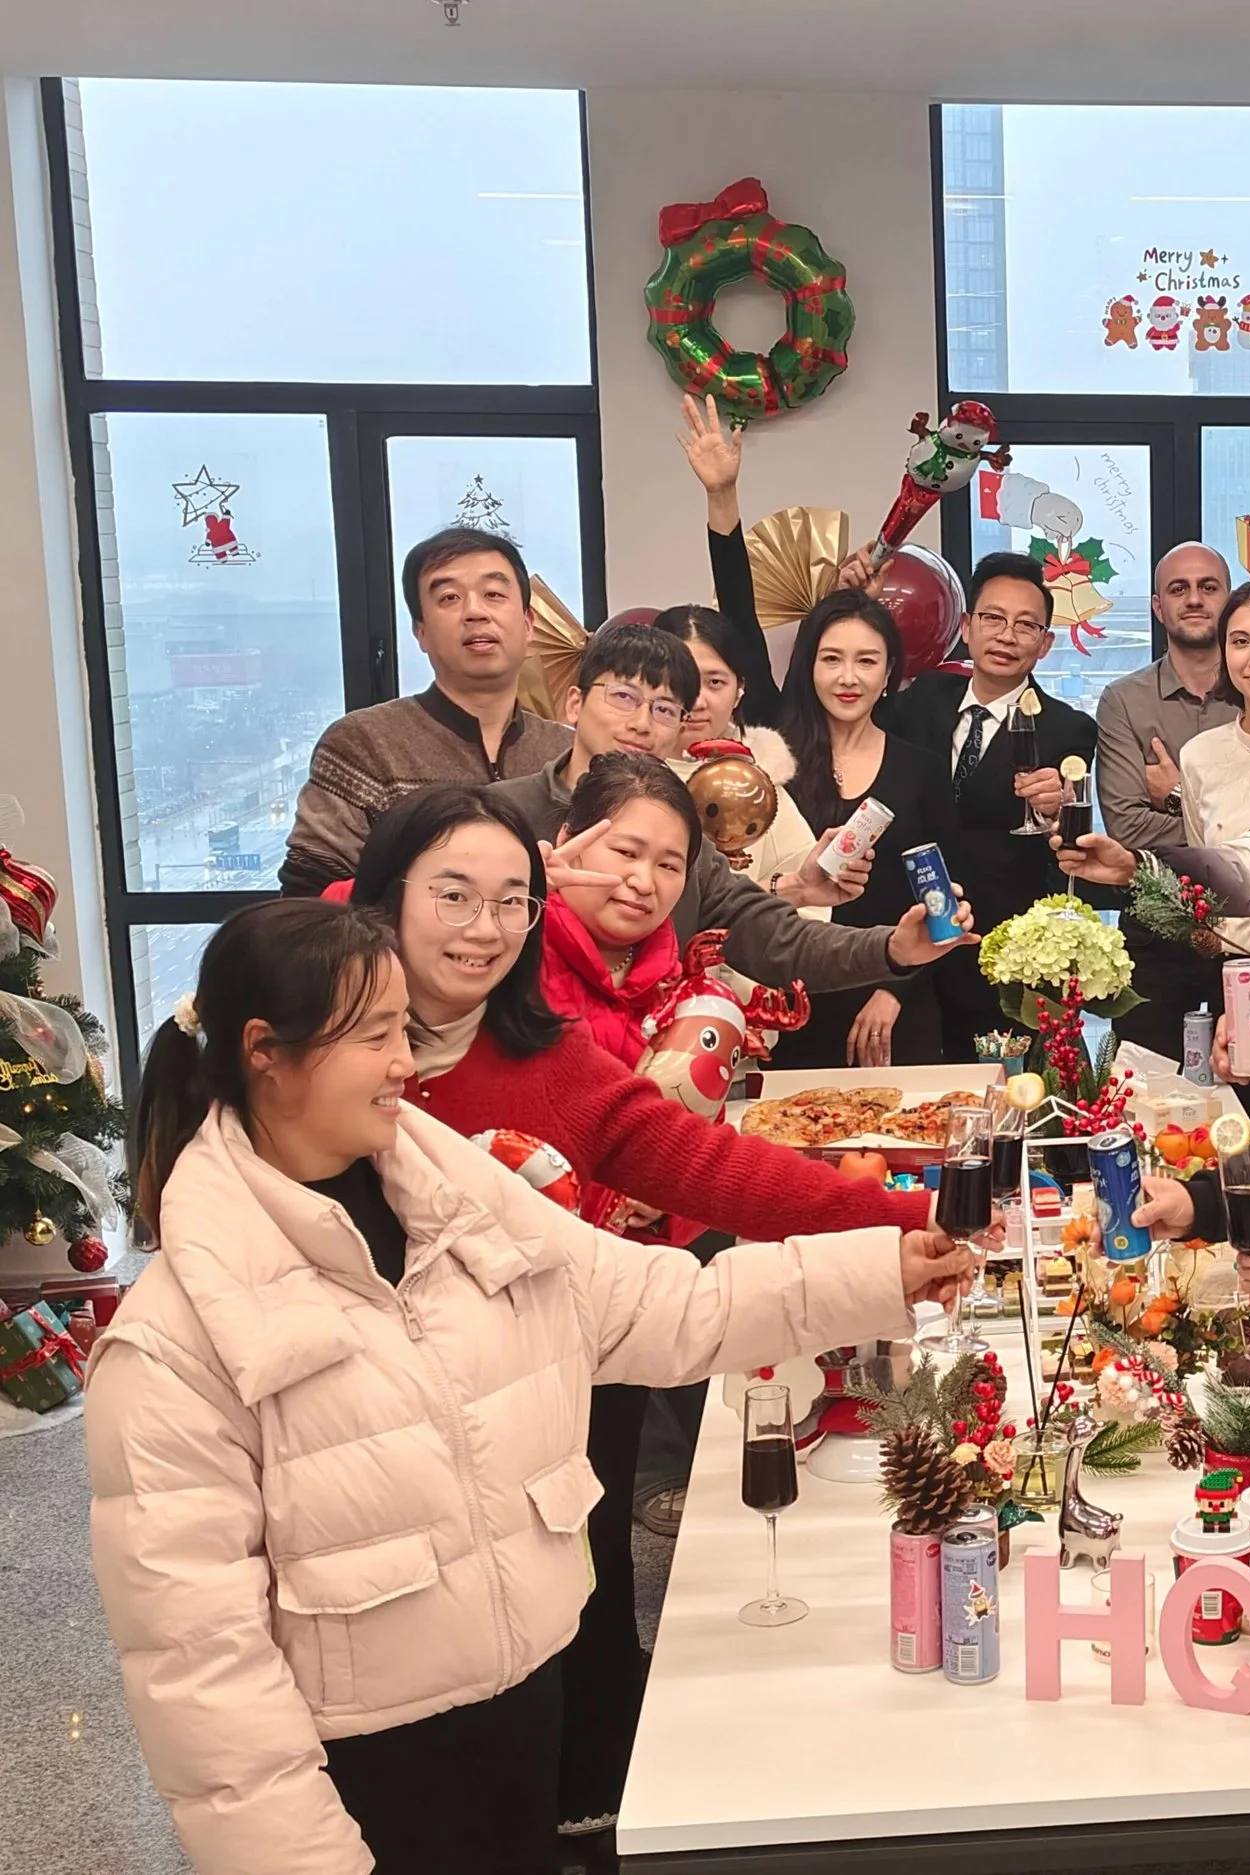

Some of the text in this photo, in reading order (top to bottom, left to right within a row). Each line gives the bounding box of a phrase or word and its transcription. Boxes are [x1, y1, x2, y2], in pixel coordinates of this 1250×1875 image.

[1143, 247, 1194, 271] Merry
[1154, 270, 1240, 292] Christmas
[1100, 453, 1133, 497] merry
[1093, 477, 1140, 534] christmas
